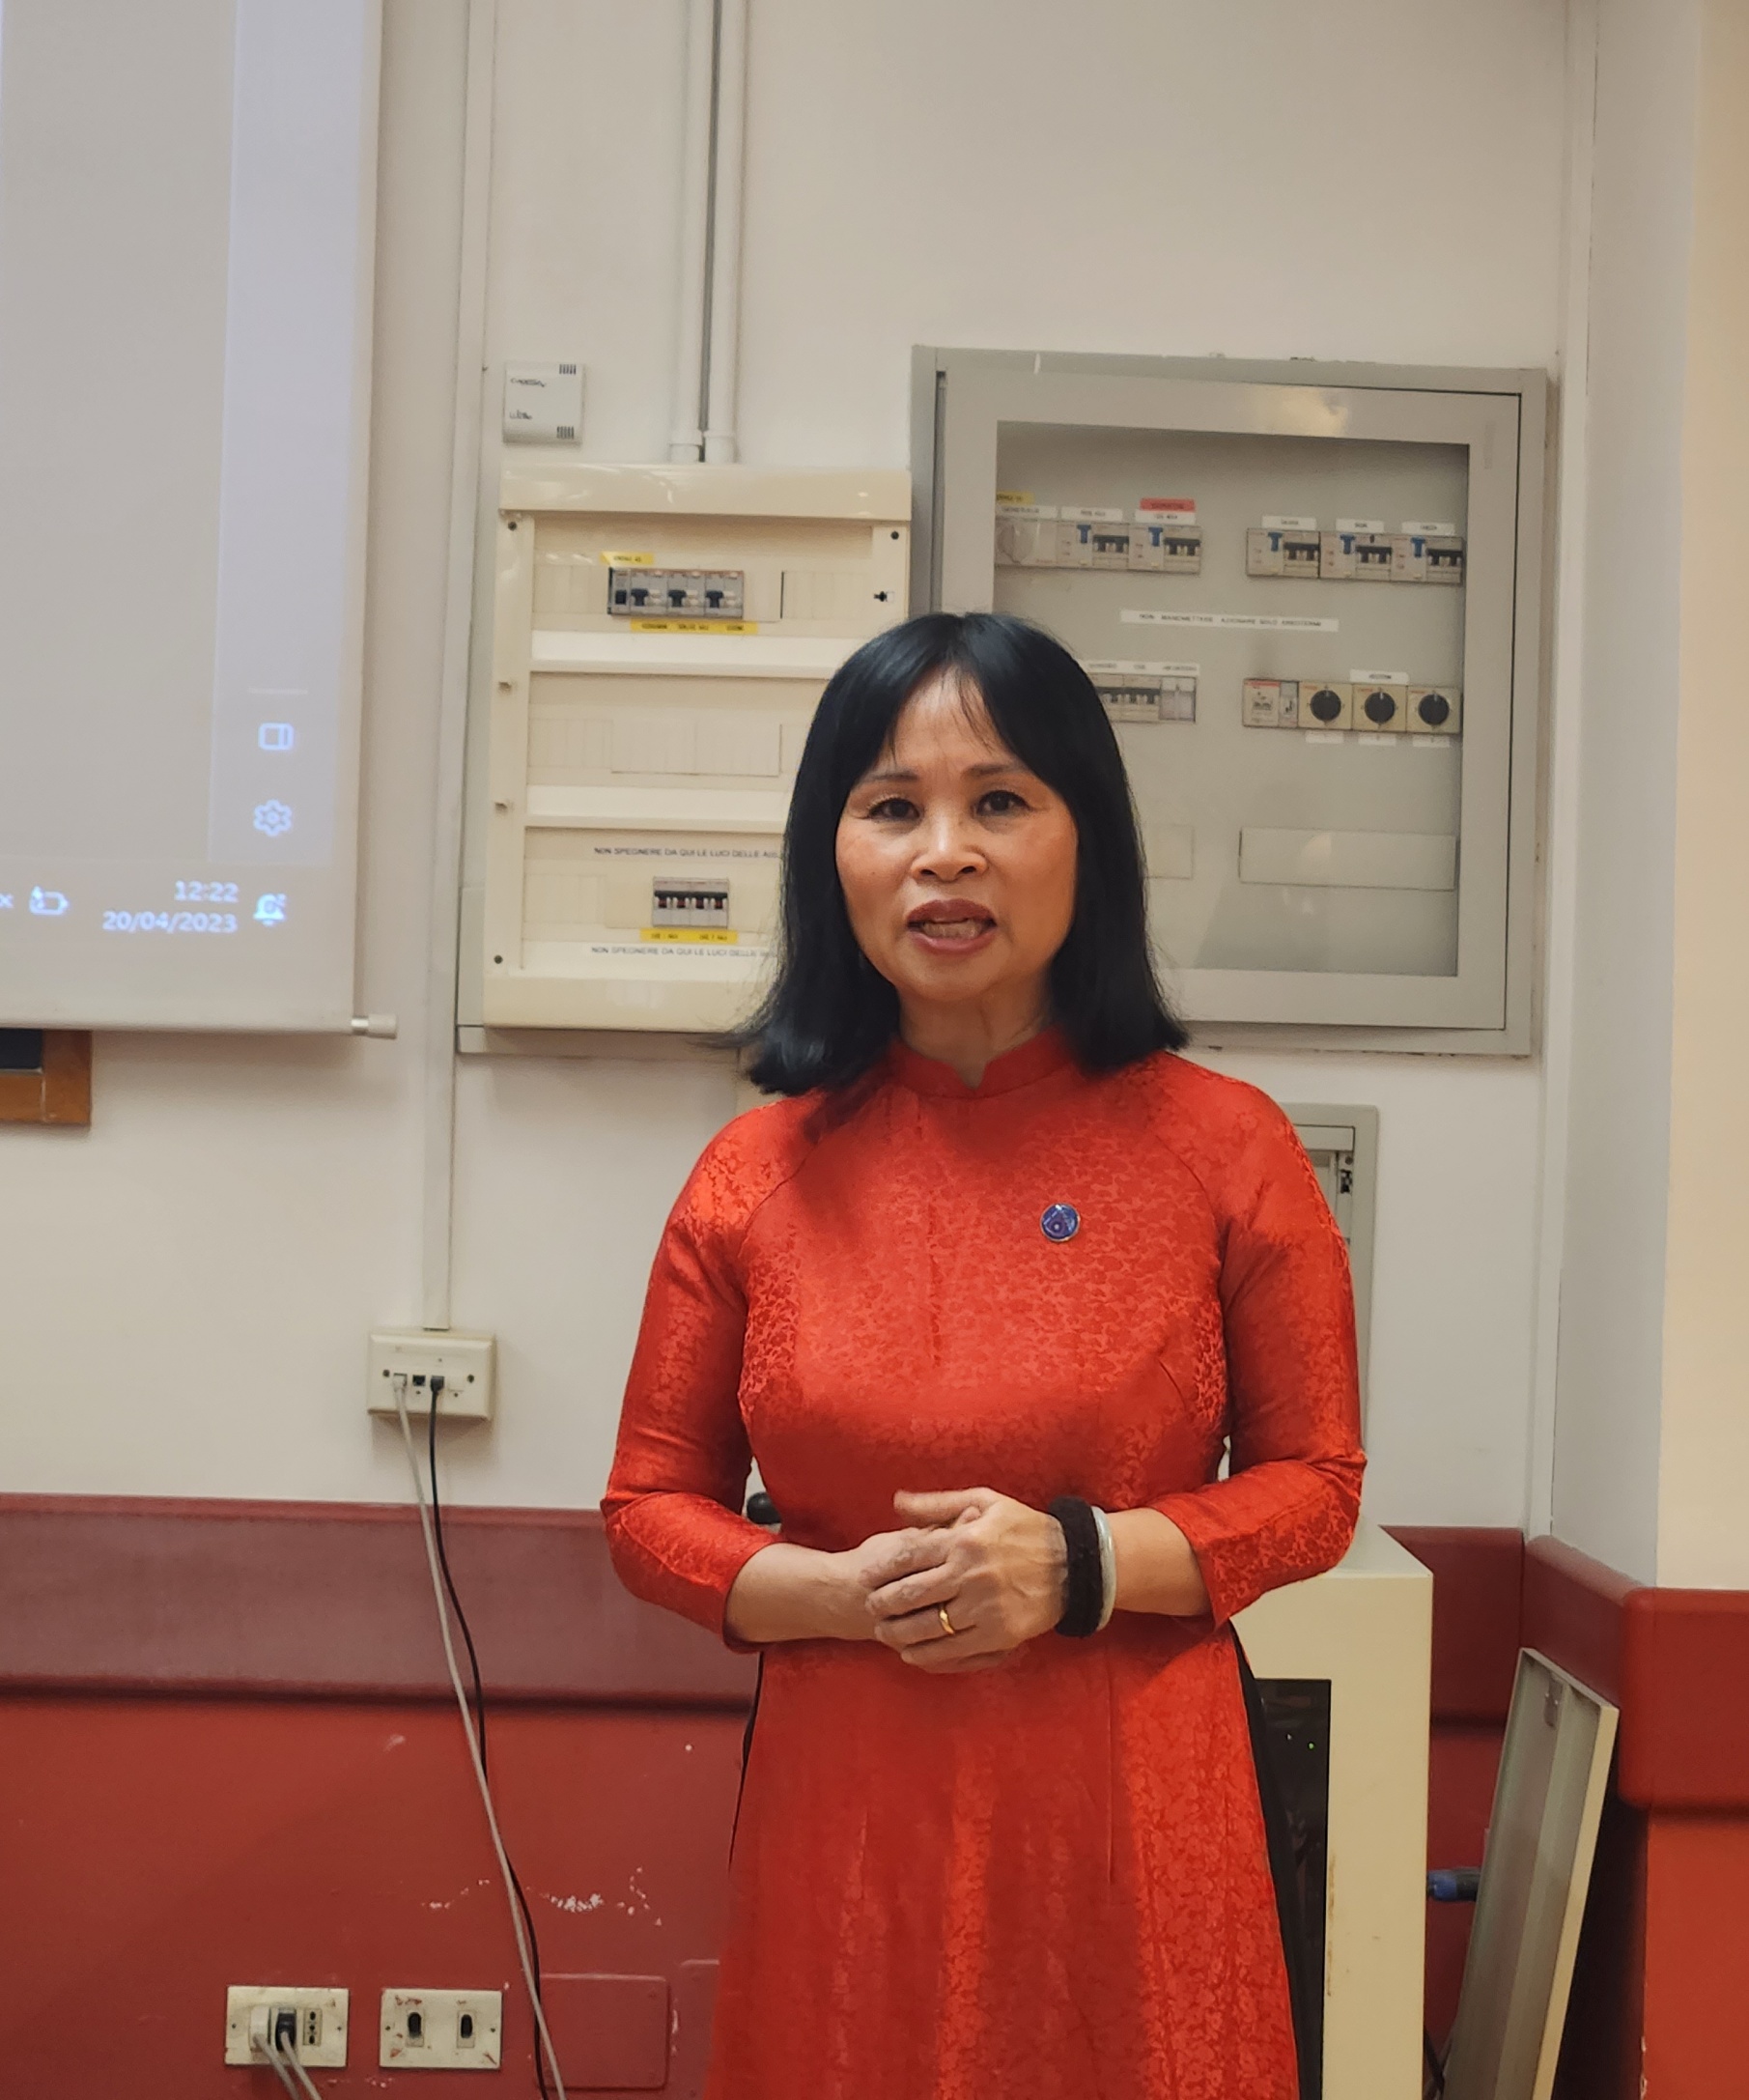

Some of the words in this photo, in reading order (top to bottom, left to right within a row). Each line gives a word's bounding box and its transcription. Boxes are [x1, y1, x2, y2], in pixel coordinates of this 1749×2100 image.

[614, 847, 662, 856] SPEGNERE
[664, 848, 677, 857] DA
[679, 848, 694, 858] QUI
[175, 880, 239, 903] 12:22
[101, 911, 238, 934] 20/04/2023
